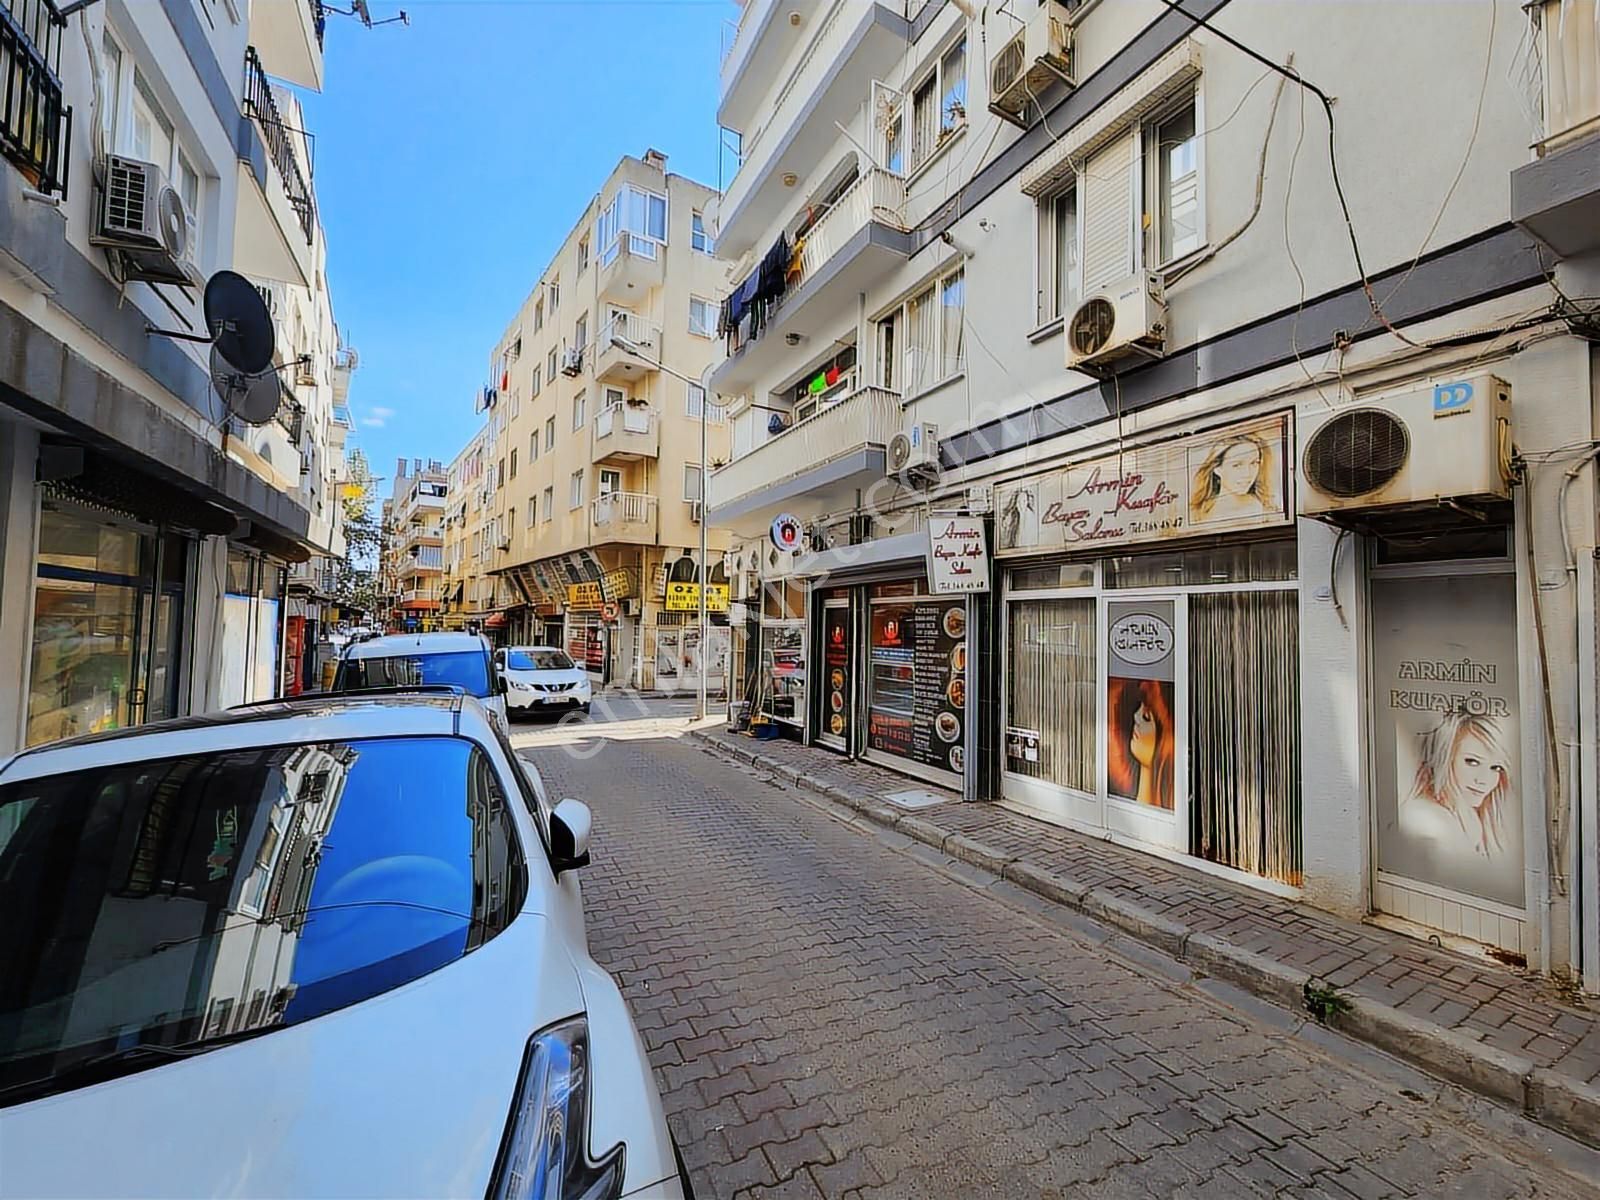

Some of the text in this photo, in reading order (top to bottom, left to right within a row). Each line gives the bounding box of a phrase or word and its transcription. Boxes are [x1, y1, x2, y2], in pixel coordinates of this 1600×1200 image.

[1067, 466, 1144, 498] Armin
[933, 521, 980, 539] Armin
[1399, 657, 1497, 684] ARMİN
[1389, 690, 1511, 717] KUAFÖR
